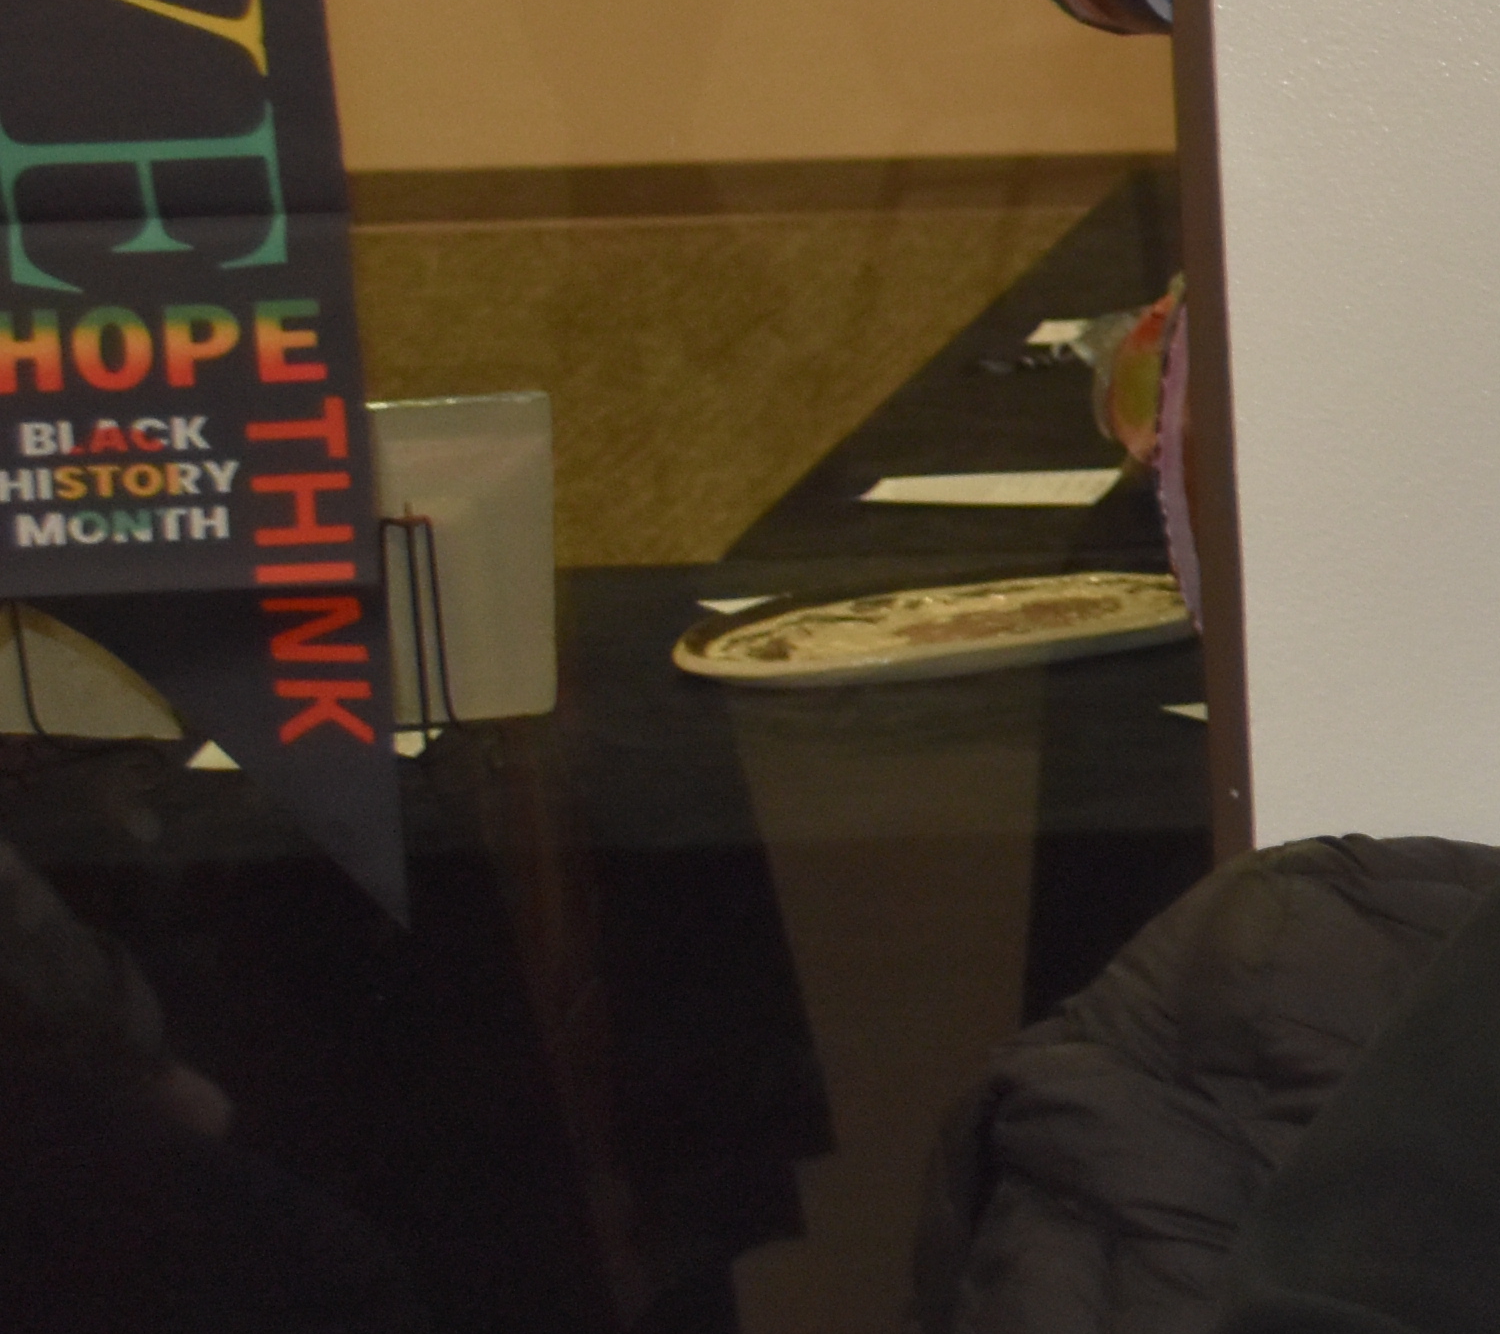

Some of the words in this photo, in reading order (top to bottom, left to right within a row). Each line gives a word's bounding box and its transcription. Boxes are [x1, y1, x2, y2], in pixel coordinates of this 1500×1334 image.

[0, 299, 328, 394] HOPE
[20, 415, 211, 457] BLACK
[0, 460, 240, 502] HISTORY
[15, 505, 230, 548] MONTH
[244, 395, 376, 746] THINK
